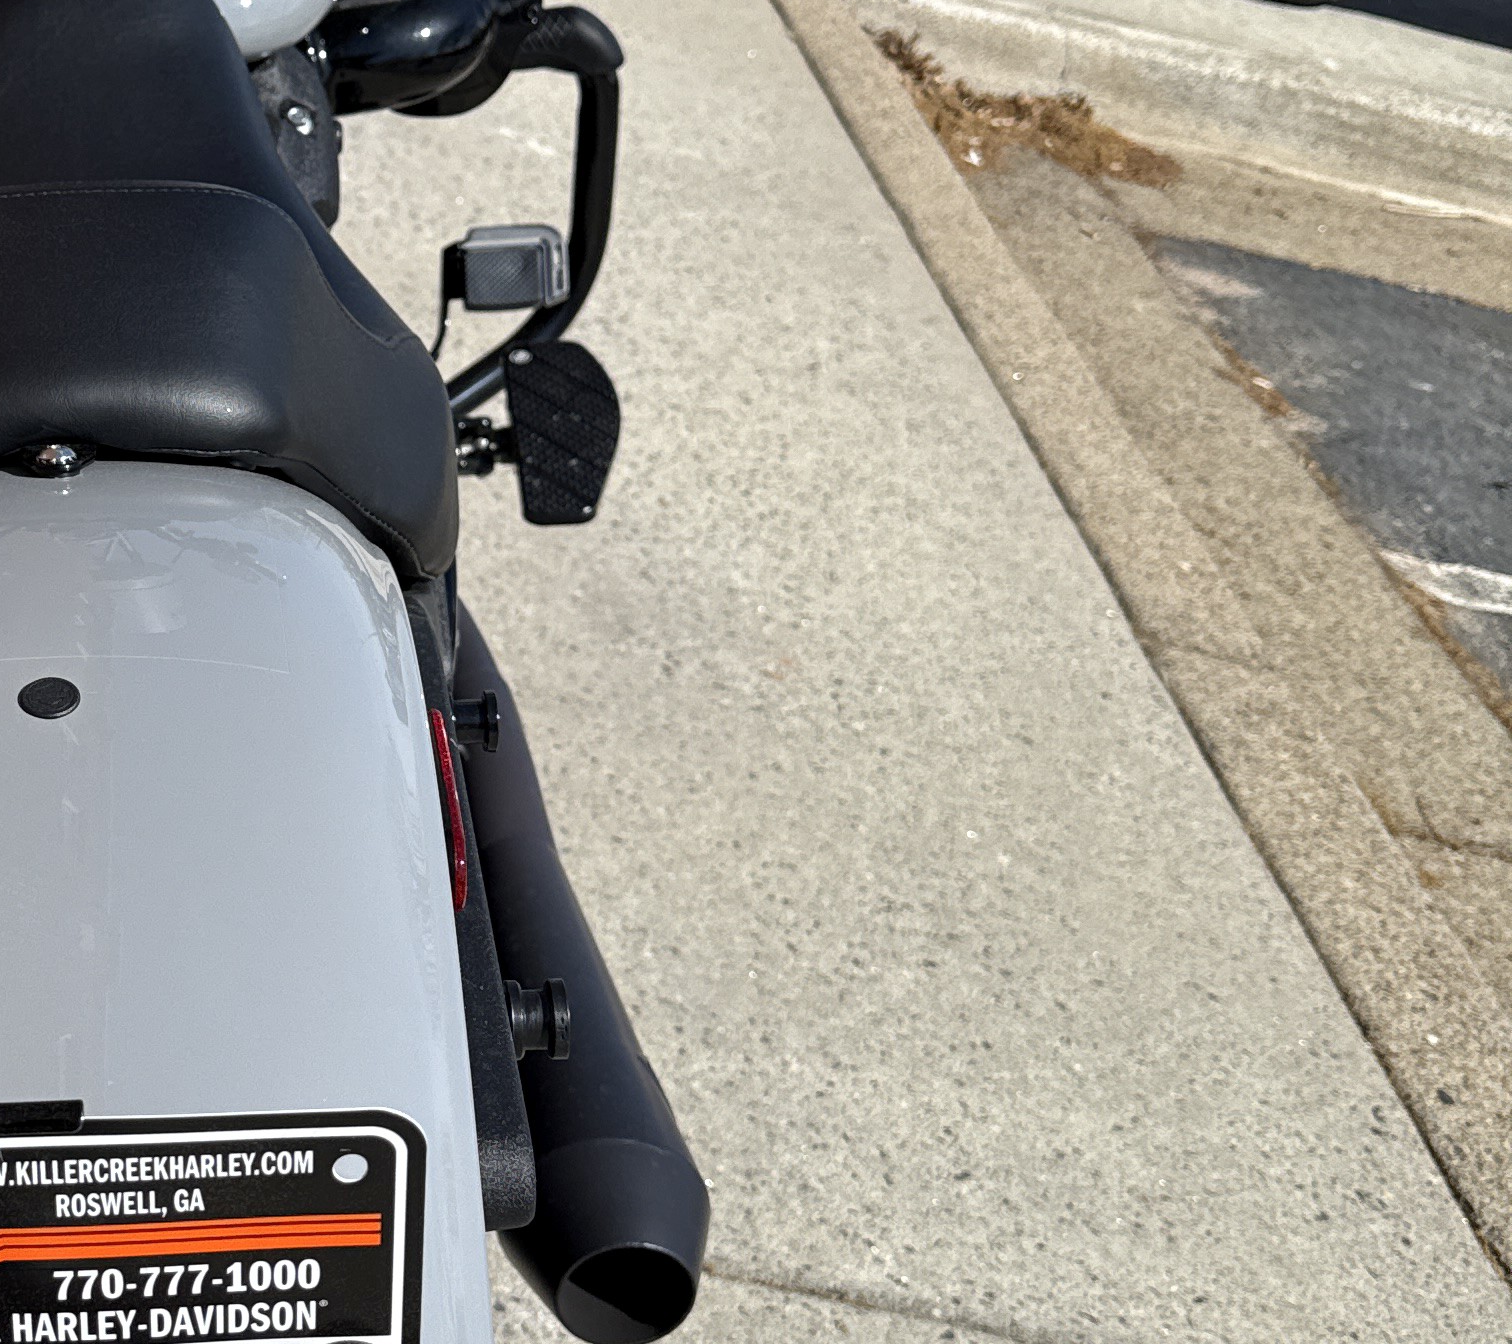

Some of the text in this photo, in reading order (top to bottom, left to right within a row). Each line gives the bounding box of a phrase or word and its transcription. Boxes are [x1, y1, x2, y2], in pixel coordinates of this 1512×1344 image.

[55, 1188, 206, 1218] ROSWELL, GA
[52, 1258, 321, 1301] 770-777-1000
[11, 1300, 317, 1343] HARLEY-DAVIDSON
